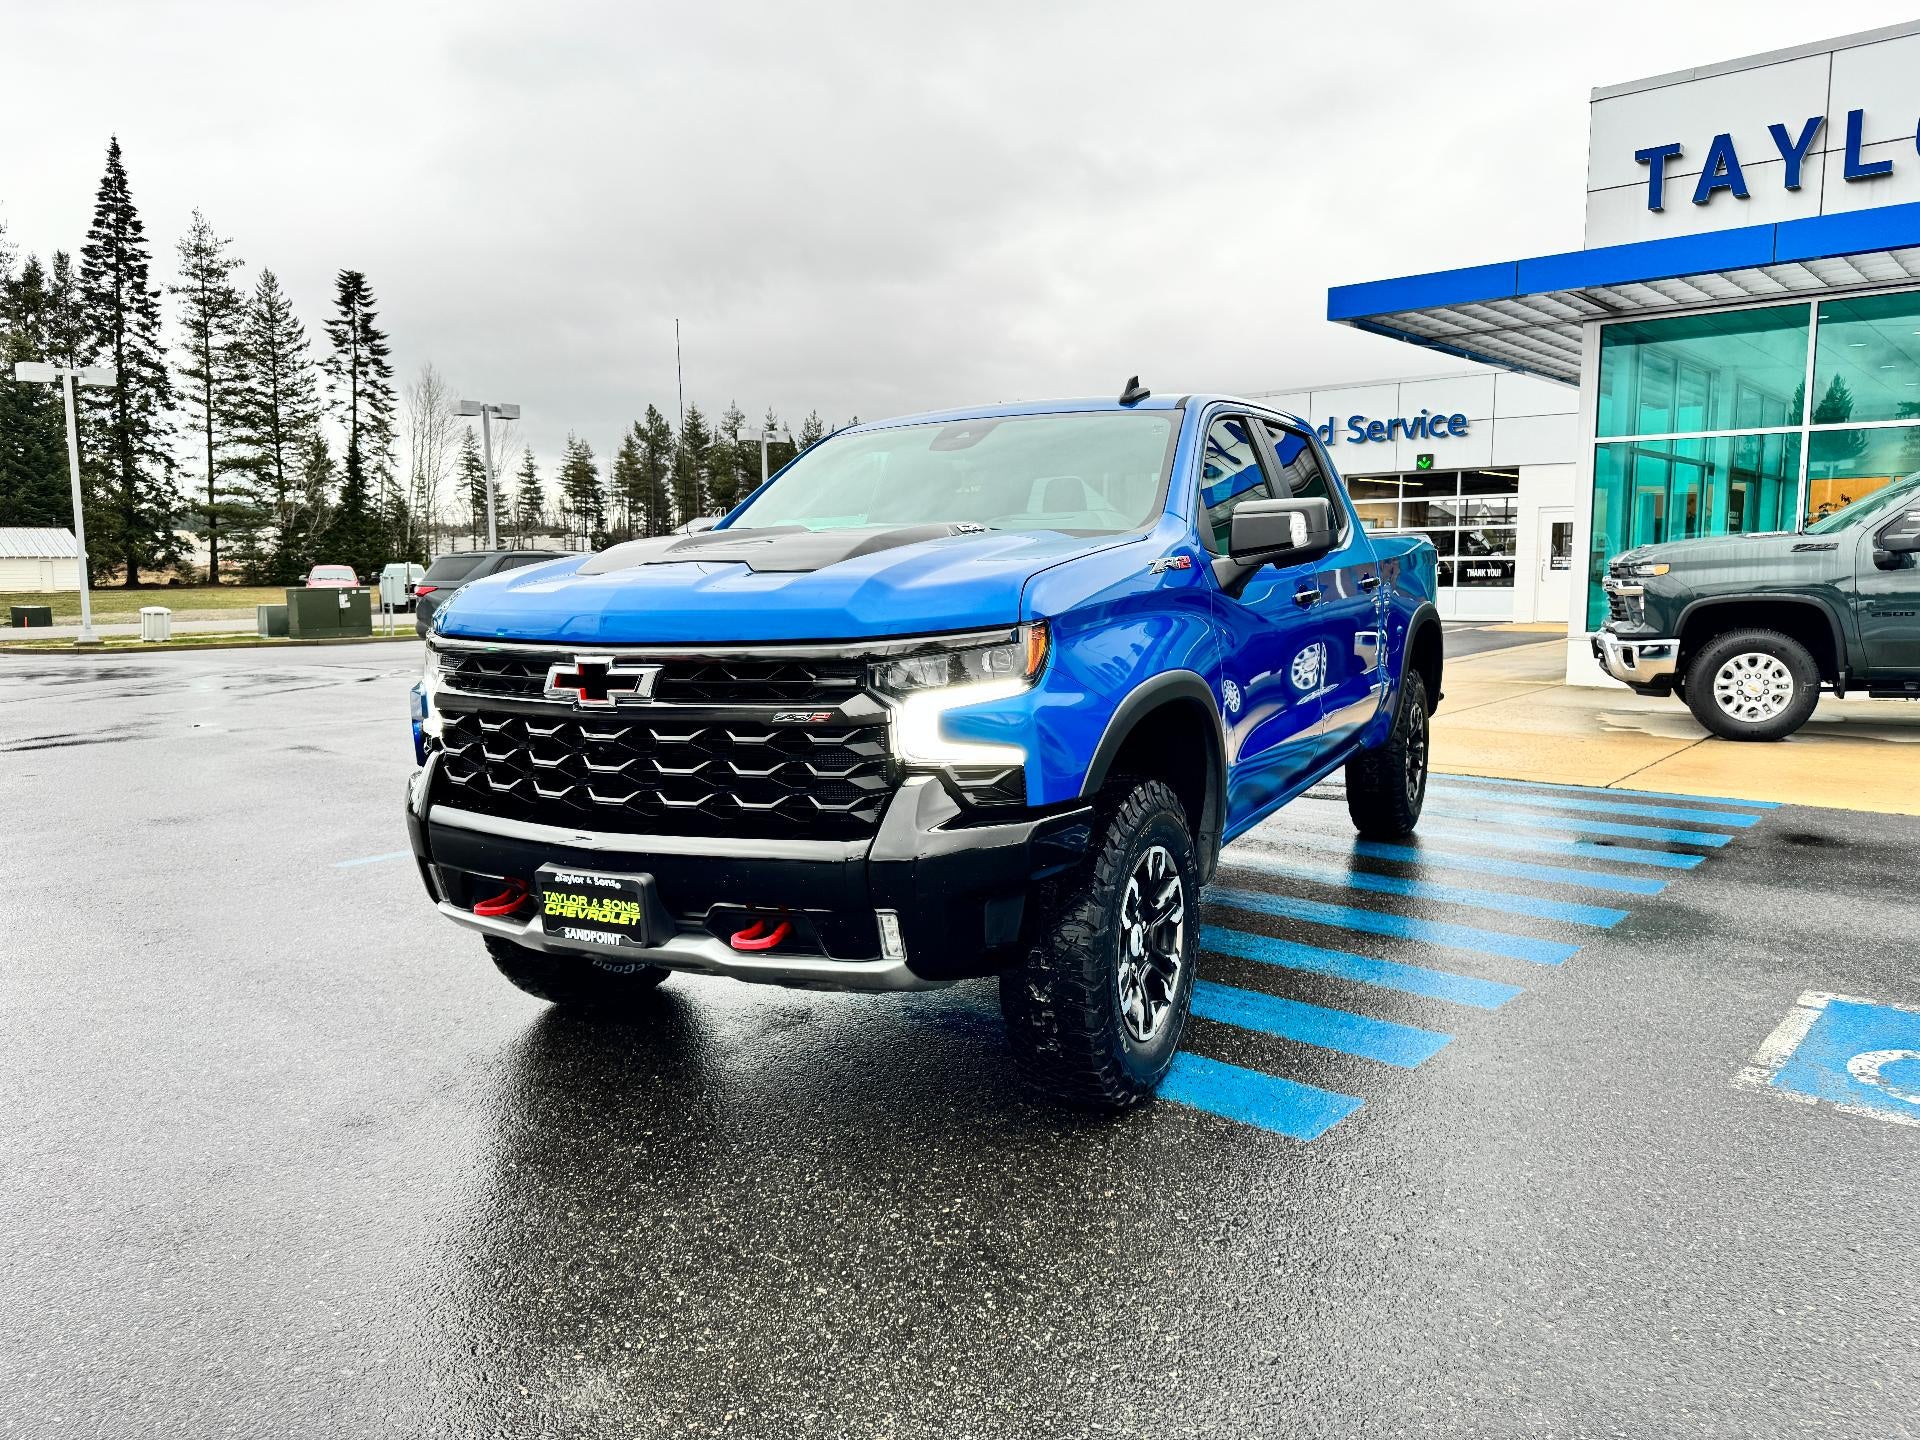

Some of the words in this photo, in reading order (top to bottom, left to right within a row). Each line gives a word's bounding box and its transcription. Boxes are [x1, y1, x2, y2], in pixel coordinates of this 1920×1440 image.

[1634, 108, 1920, 213] TAYL
[1346, 409, 1469, 443] Service
[1466, 568, 1486, 577] THANK
[543, 891, 588, 907] TAYLOR
[591, 898, 601, 909] &
[602, 898, 640, 913] SONS
[544, 904, 641, 925] CHEVROLET
[564, 927, 622, 945] SANDPOINT
